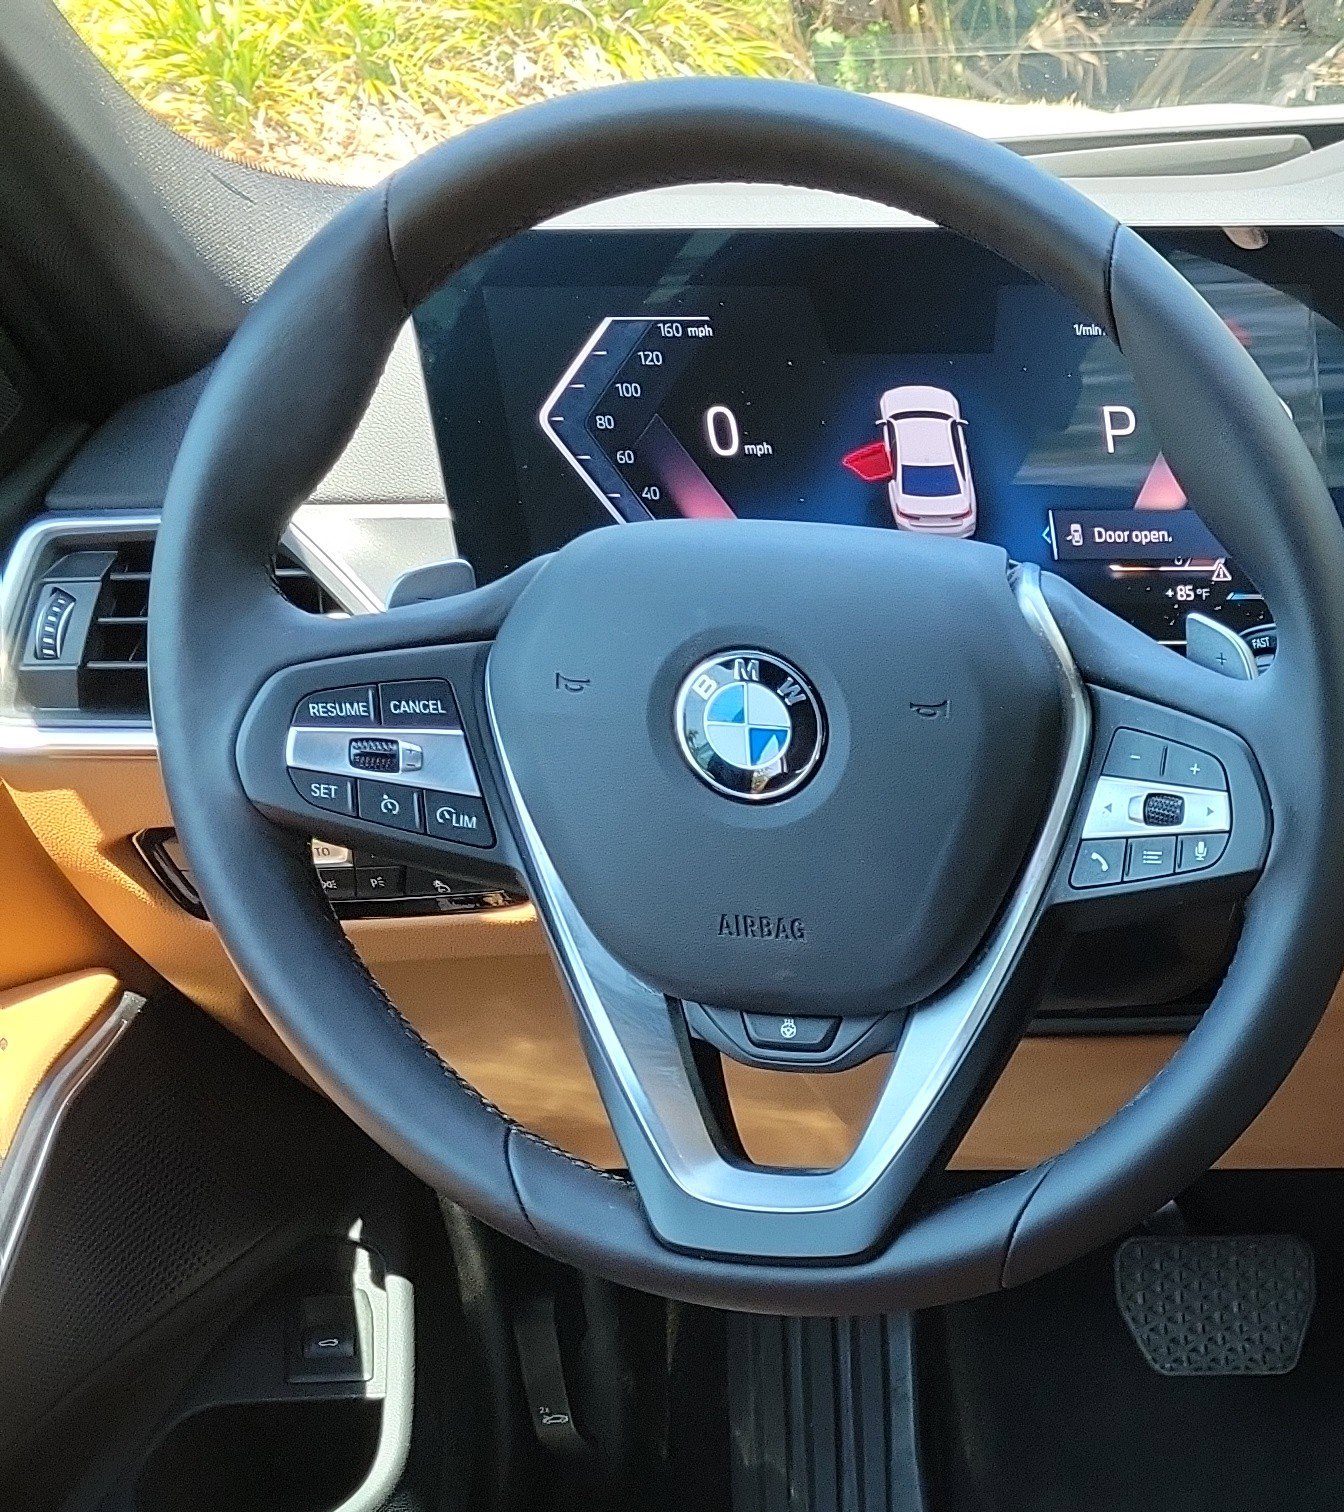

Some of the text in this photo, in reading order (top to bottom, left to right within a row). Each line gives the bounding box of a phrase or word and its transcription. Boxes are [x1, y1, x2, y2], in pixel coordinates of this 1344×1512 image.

[657, 322, 714, 338] 160 mph
[637, 350, 663, 366] 120
[615, 382, 641, 398] 100
[595, 415, 615, 430] 80
[1102, 405, 1136, 454] P
[706, 405, 774, 458] 0 mph
[616, 449, 635, 465] 60
[641, 486, 660, 501] 40
[1093, 527, 1174, 545] Door open.
[1251, 636, 1271, 649] FAST
[692, 658, 807, 706] BMW
[308, 702, 369, 718] RESUME
[390, 699, 447, 715] CANCEL
[310, 784, 338, 799] SET
[451, 814, 478, 830] LIM
[717, 913, 806, 941] AIRBAG
